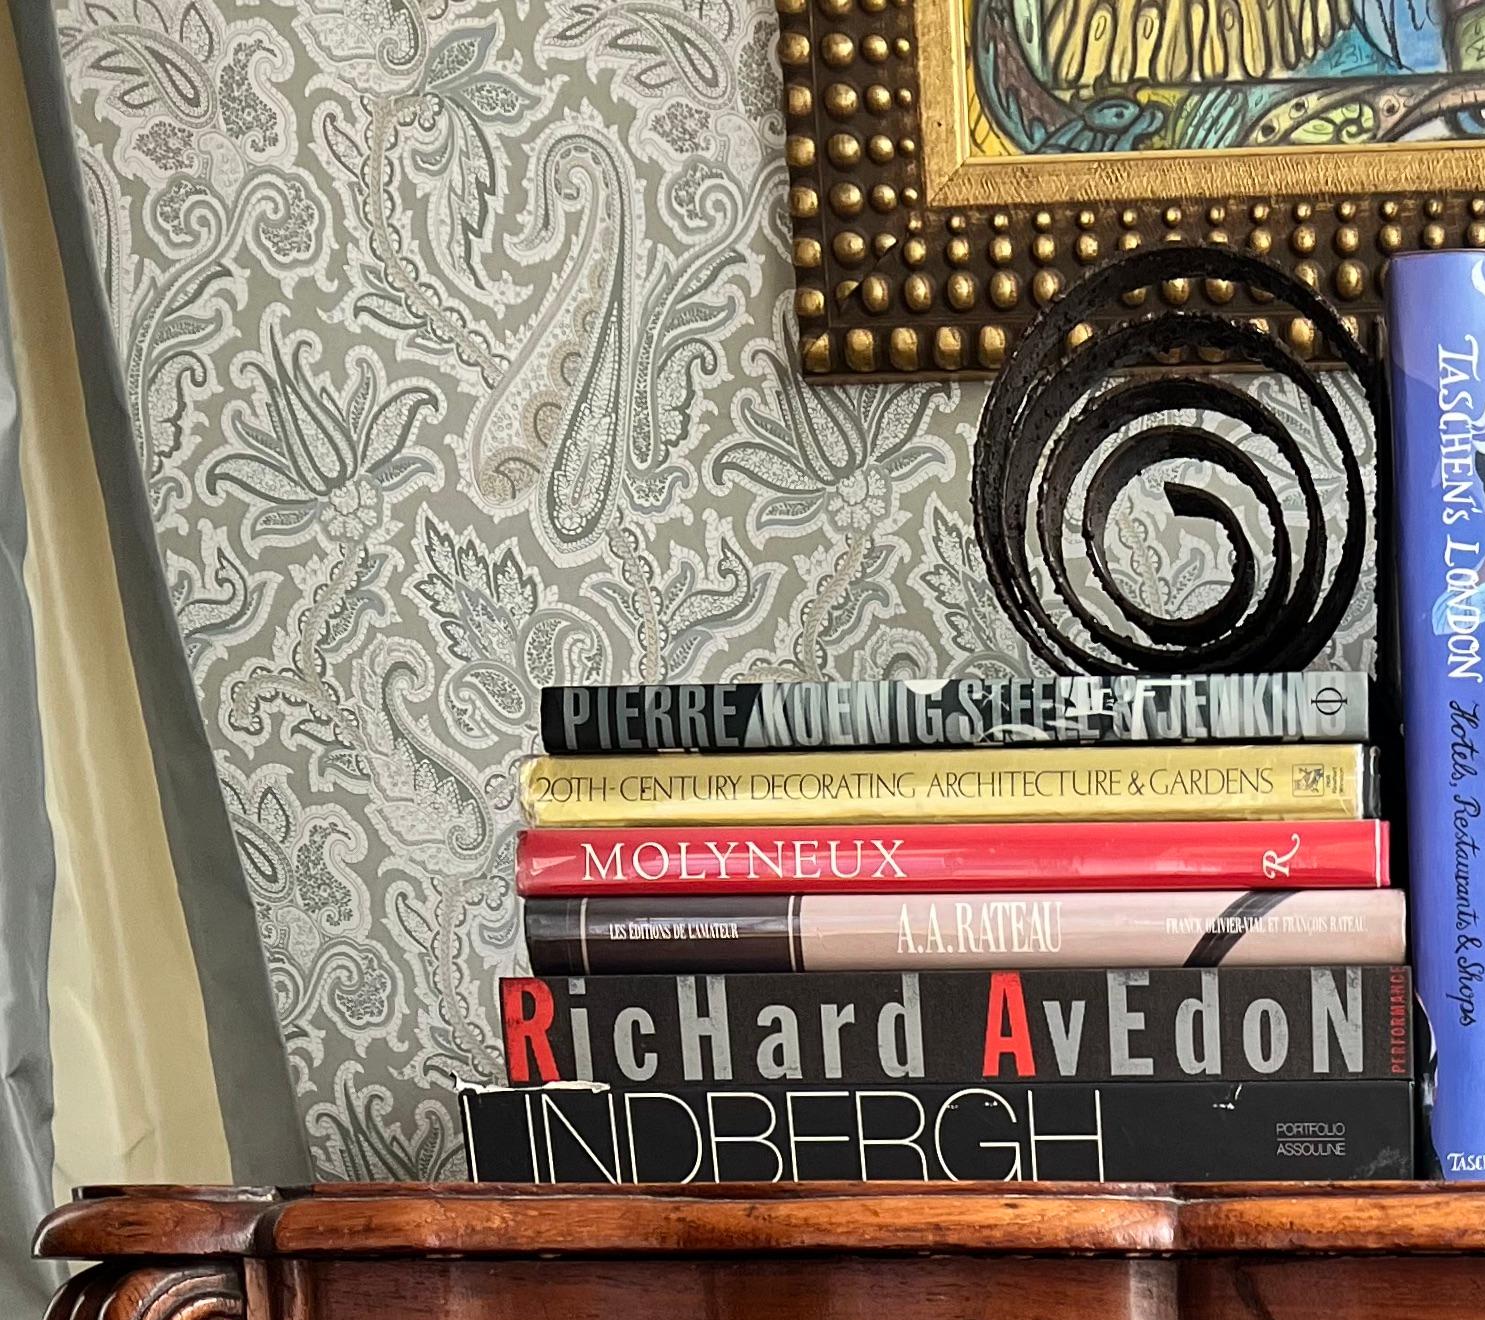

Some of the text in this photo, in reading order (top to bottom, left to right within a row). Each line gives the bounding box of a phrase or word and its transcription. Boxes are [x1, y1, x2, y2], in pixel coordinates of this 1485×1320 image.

[1444, 534, 1483, 684] LONDON
[563, 684, 741, 751] PIERRE
[758, 680, 945, 747] KOENIG
[536, 767, 1275, 803] 20TH-CENTURY DECORATING ARCHITECTURE & GARDENS
[581, 839, 908, 881] MOLYNEUX
[1262, 833, 1301, 880] R
[1447, 699, 1485, 1027] Hotels, Restaurants & Shops
[609, 923, 627, 940] LES
[673, 922, 687, 939] DE
[1165, 917, 1202, 934] FRANCK
[1205, 916, 1267, 934] OLIVIER-VIAL
[1268, 917, 1280, 933] ET
[1389, 967, 1407, 1075] PERFORMANCE
[1276, 1122, 1346, 1138] PORTFOLIO
[1276, 1142, 1346, 1157] ASSOULINE
